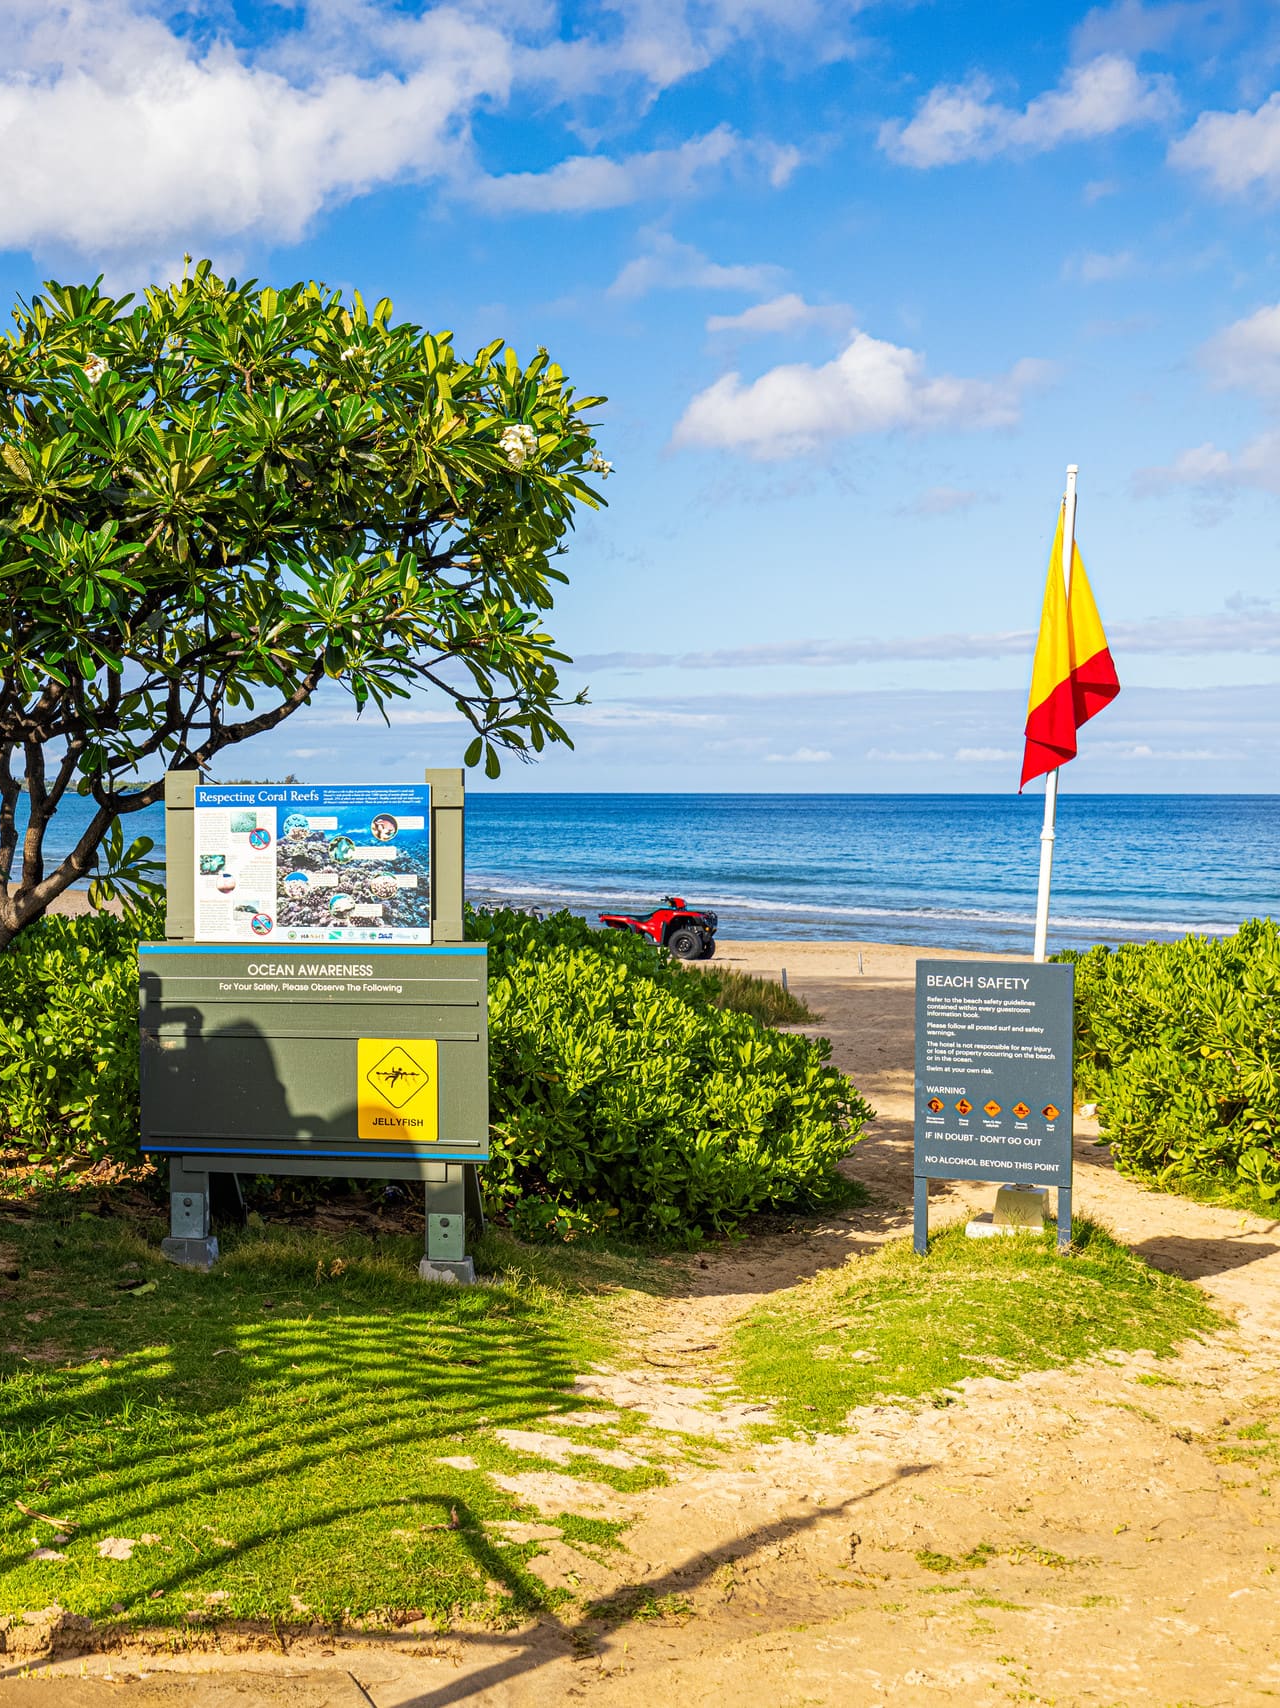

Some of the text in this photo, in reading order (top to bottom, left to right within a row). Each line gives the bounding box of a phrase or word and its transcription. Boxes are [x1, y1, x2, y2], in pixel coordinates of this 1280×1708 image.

[200, 792, 255, 804] Respecting
[258, 790, 286, 801] Coral
[290, 790, 319, 801] Reefs
[248, 964, 373, 976] OCEAN AWARENESS
[233, 983, 252, 991] Your
[254, 983, 280, 992] Safety,
[282, 983, 309, 991] Please
[311, 984, 344, 992] Observe
[346, 984, 360, 992] The
[362, 984, 402, 993] Following
[926, 975, 1030, 990] BEACH SAFETY
[984, 998, 1002, 1006] safety
[976, 1024, 997, 1032] posted
[1025, 1026, 1044, 1034] safety
[926, 1086, 966, 1095] WARNING
[372, 1118, 423, 1126] JELLYFISH
[934, 1132, 943, 1140] IN
[945, 1133, 974, 1142] DOUBT
[980, 1135, 1006, 1144] DON'T
[1008, 1137, 1021, 1145] GO
[1023, 1138, 1042, 1146] OUT
[925, 1155, 1060, 1172] NO ALCOHOL BEYOND THIS POINT
